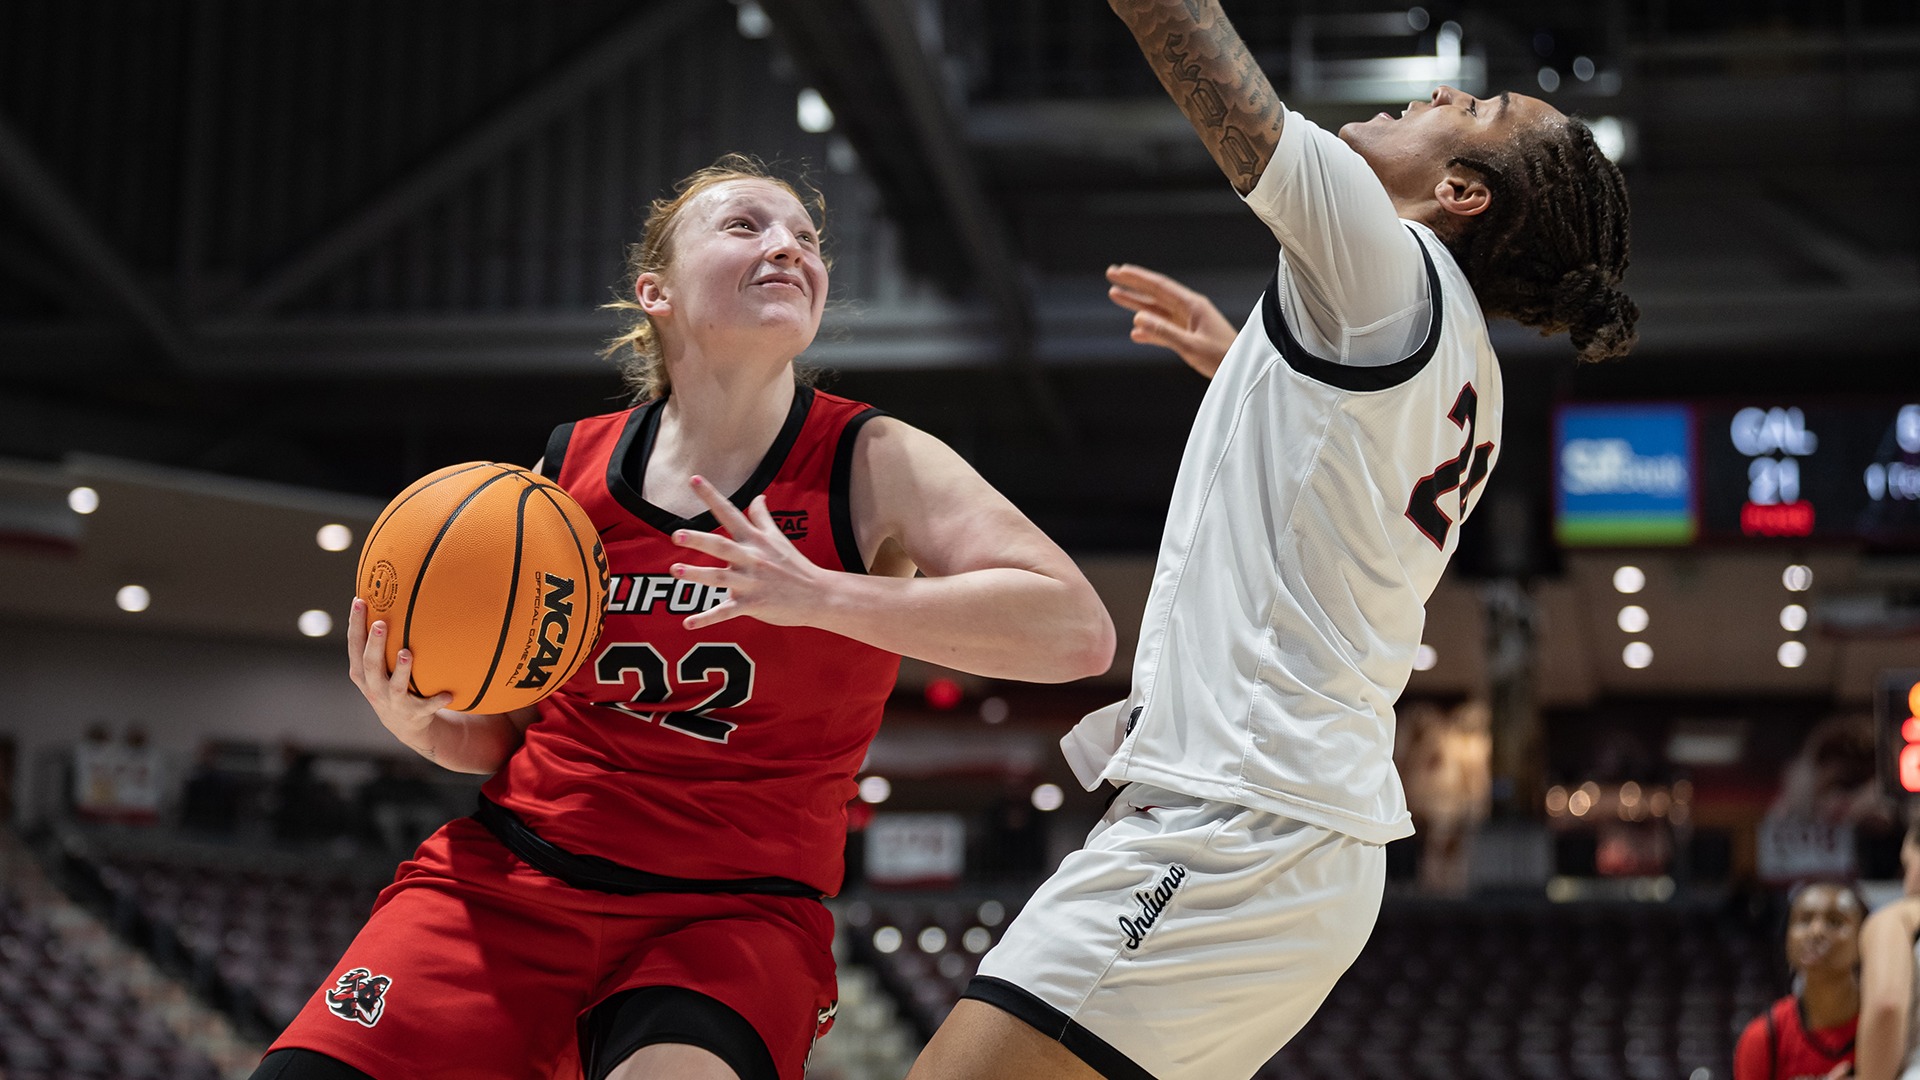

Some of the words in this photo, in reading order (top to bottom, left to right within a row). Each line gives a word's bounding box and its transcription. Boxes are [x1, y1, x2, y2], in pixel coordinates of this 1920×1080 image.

[1730, 407, 1818, 456] CAL
[531, 571, 541, 626] OFFICIAL
[514, 571, 575, 689] NCAA
[521, 628, 536, 661] GAME
[505, 663, 524, 687] BALL
[590, 642, 756, 744] 22
[1118, 864, 1186, 950] Indiana
